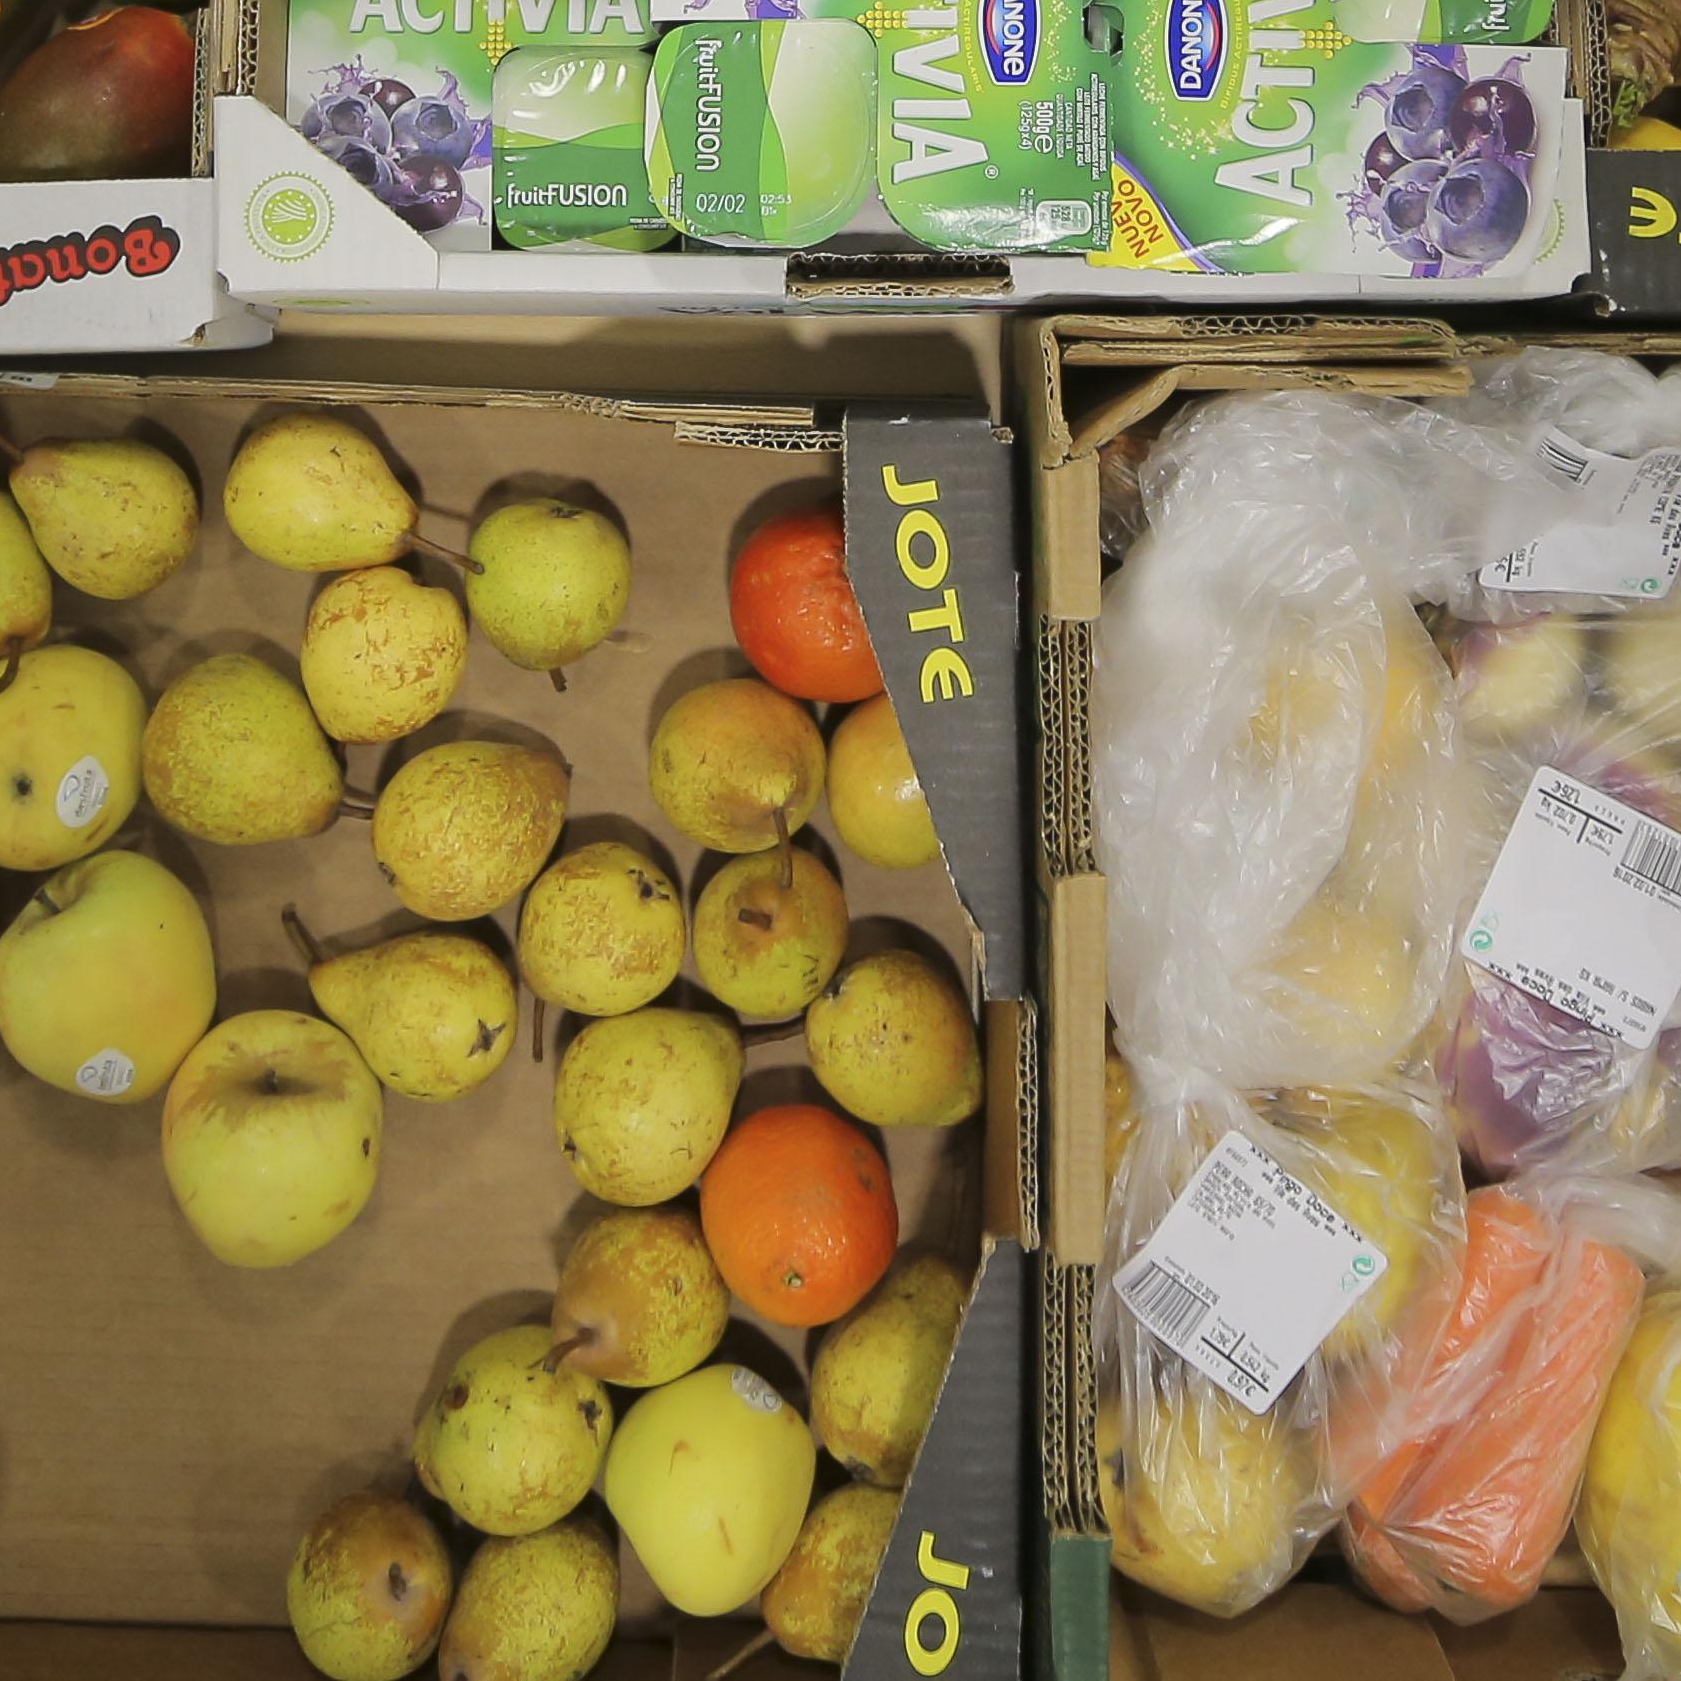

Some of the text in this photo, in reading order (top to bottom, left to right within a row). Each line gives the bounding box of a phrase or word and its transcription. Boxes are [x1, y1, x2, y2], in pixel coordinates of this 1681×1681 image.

[694, 38, 723, 172] fruitFUSION
[1018, 99, 1034, 150] (125gx4)
[1033, 101, 1054, 134] 500g
[506, 181, 628, 208] fruitFUSION
[695, 193, 746, 214] 02/02
[1117, 179, 1165, 244] NOVO
[1111, 201, 1150, 259] NUEV
[881, 462, 975, 705] JOTE
[1520, 975, 1596, 1024] Pingo Doce
[1273, 1166, 1336, 1224] Pingo Doce
